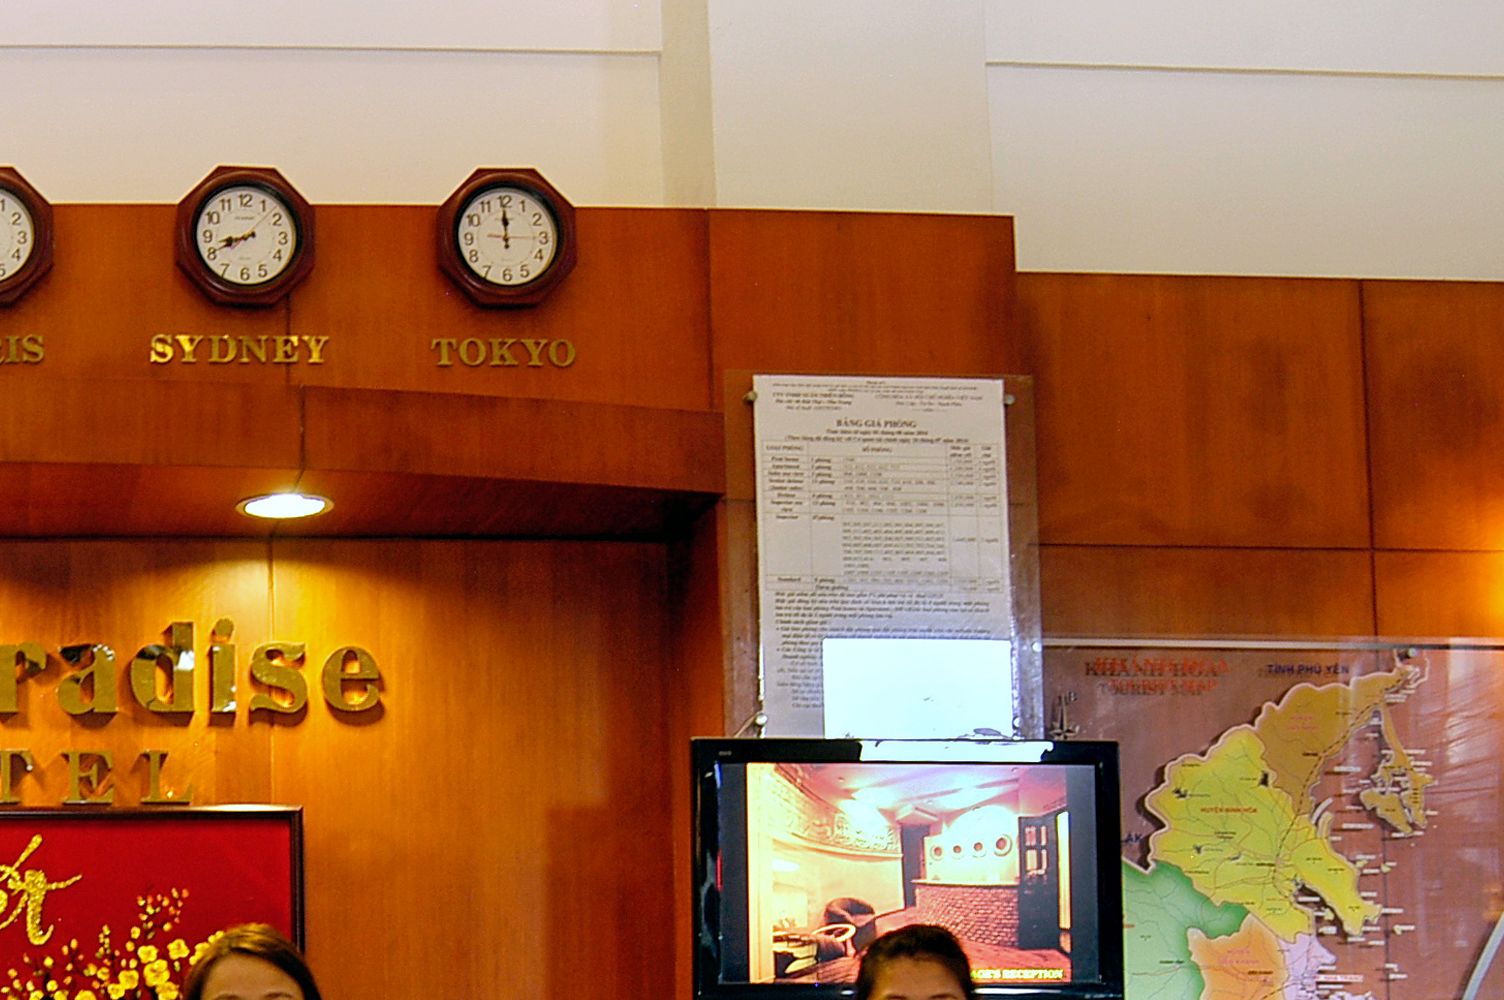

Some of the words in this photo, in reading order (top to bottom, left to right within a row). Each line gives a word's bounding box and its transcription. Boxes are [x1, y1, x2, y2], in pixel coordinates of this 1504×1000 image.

[0, 198, 5, 212] 1
[219, 198, 231, 212] 11
[238, 193, 253, 208] 12
[260, 199, 266, 212] 1
[478, 200, 491, 213] 11
[497, 194, 512, 209] 12
[519, 199, 526, 213] 1
[12, 212, 22, 226] 2
[205, 211, 220, 225] 10
[272, 212, 282, 227] 2
[466, 213, 481, 227] 10
[532, 212, 542, 226] 2
[17, 230, 27, 245] 3
[202, 229, 213, 243] 9
[278, 231, 288, 245] 3
[464, 232, 474, 246] 9
[539, 231, 549, 245] 3
[11, 248, 21, 261] 4
[207, 247, 217, 261] 8
[272, 249, 282, 262] 4
[469, 249, 479, 263] 8
[534, 248, 544, 262] 4
[217, 263, 230, 278] 7
[240, 267, 250, 281] 6
[258, 264, 268, 278] 5
[480, 265, 491, 279] 7
[502, 268, 513, 282] 6
[520, 264, 530, 278] 5
[149, 333, 331, 365] SYDNEY
[430, 337, 576, 368] TOKYO
[1003, 968, 1064, 980] RECEPTION
